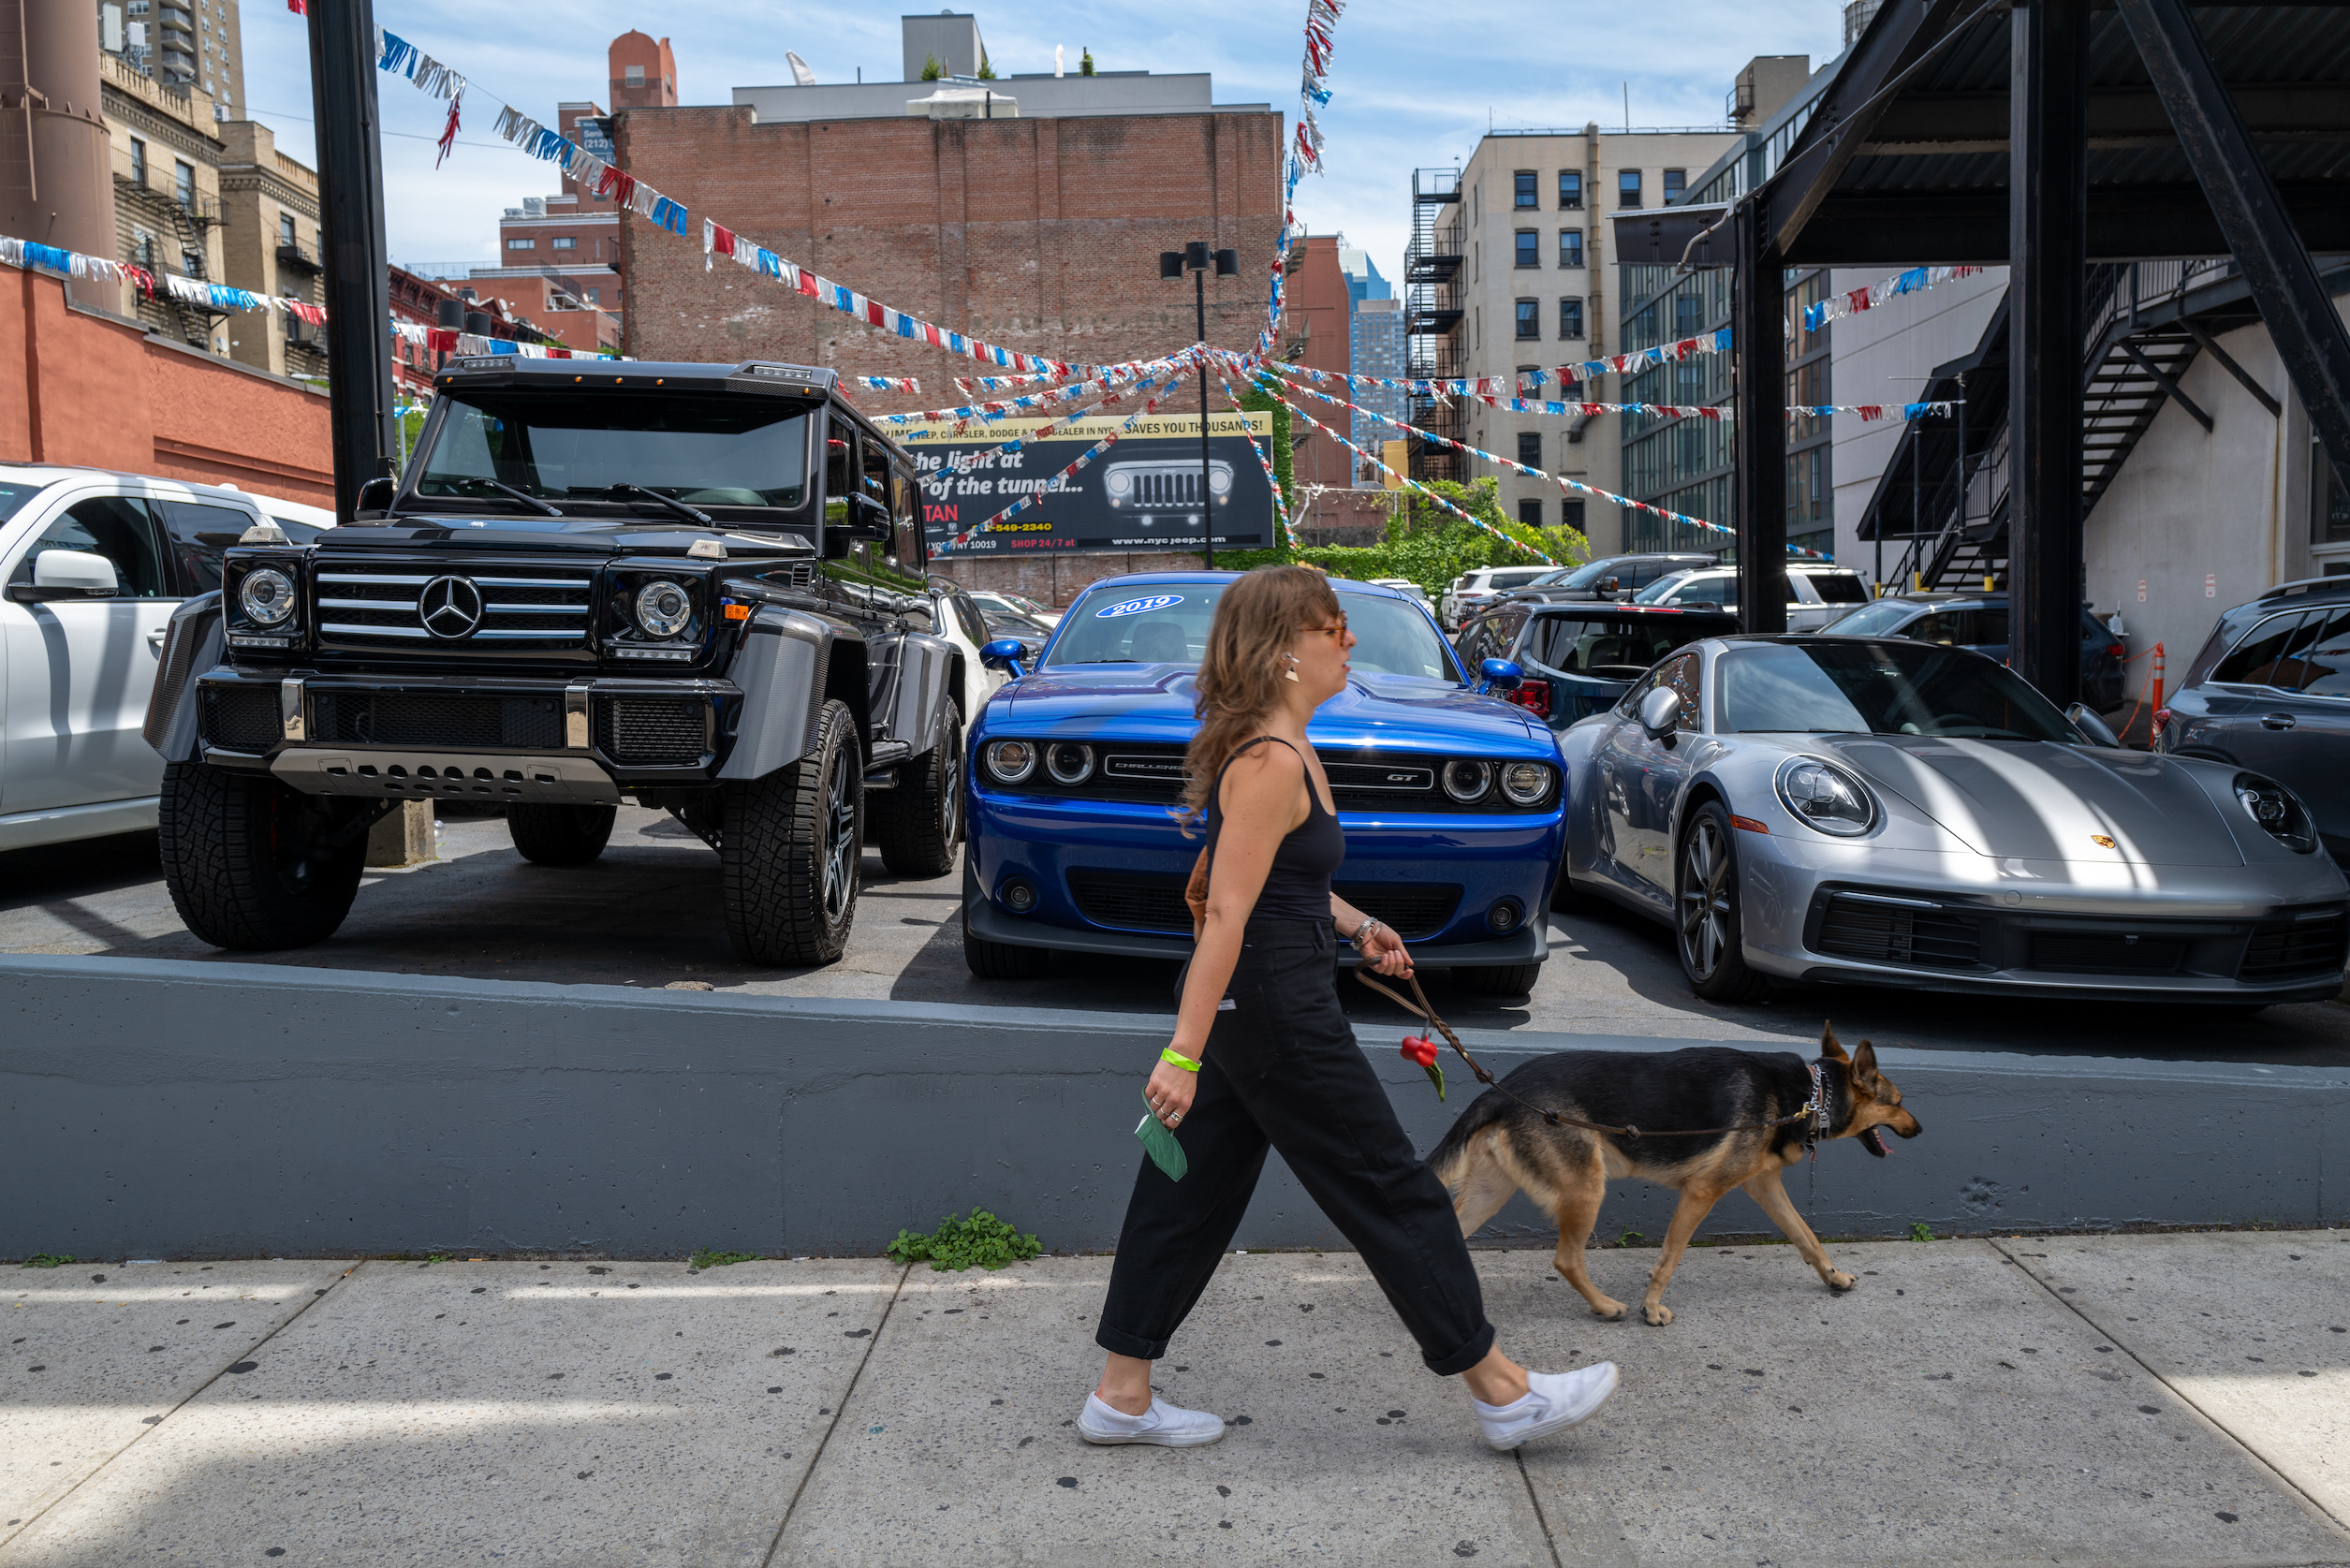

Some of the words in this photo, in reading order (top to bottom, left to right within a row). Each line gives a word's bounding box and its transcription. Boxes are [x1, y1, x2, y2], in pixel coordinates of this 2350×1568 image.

[584, 139, 609, 150] (212)
[990, 428, 1019, 438] DODGE
[1021, 428, 1028, 436] &
[1086, 426, 1095, 435] IN
[1124, 423, 1161, 434] SAVES
[1163, 421, 1186, 433] YOU
[910, 451, 942, 471] he
[947, 450, 995, 475] light
[1000, 451, 1024, 469] at
[929, 476, 954, 501] of
[956, 476, 993, 495] the
[923, 504, 958, 521] TAN
[971, 522, 1052, 532] 22-549-2340
[970, 540, 997, 550] 10019
[1011, 539, 1036, 549] SHOP
[1038, 538, 1064, 549] 24/7
[1065, 538, 1075, 548] at
[1110, 596, 1171, 616] 2019
[1115, 762, 1185, 770] CHALLENG
[1387, 773, 1418, 782] GT
